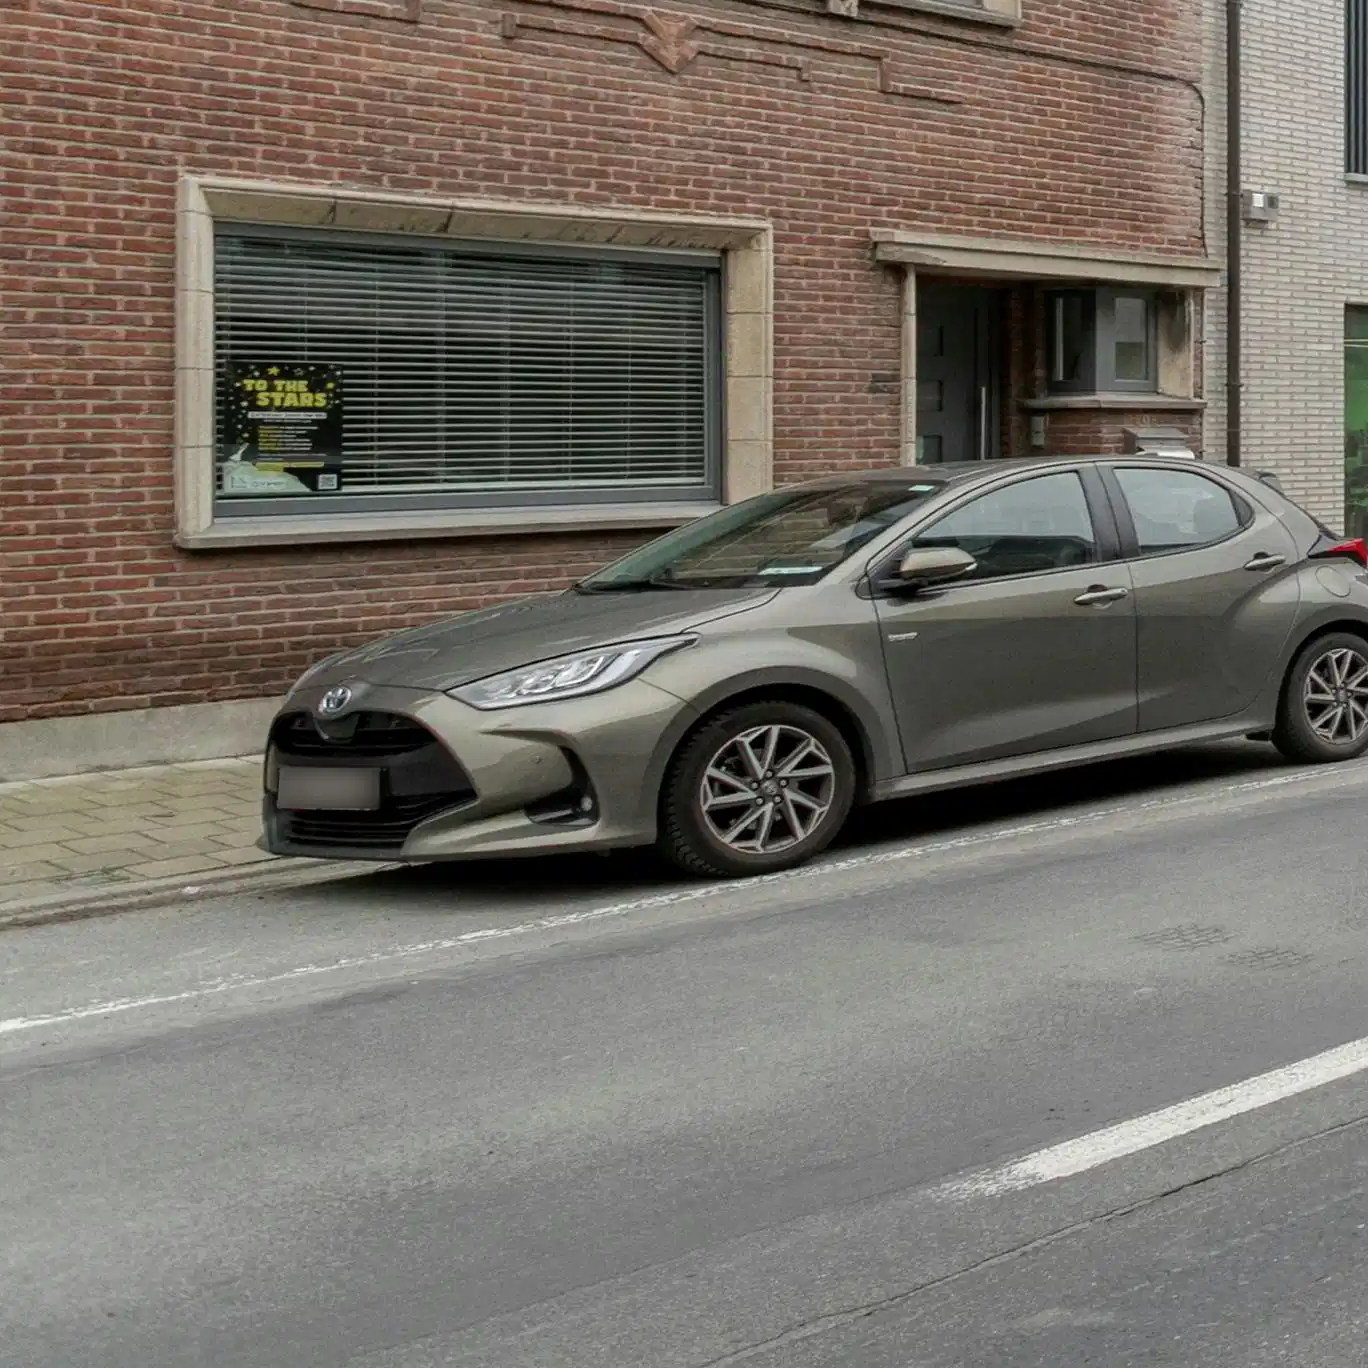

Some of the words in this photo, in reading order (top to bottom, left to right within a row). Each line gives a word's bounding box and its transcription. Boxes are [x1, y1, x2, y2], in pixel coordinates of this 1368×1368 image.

[242, 379, 268, 391] TO
[272, 380, 309, 392] THE
[256, 391, 328, 407] STARS
